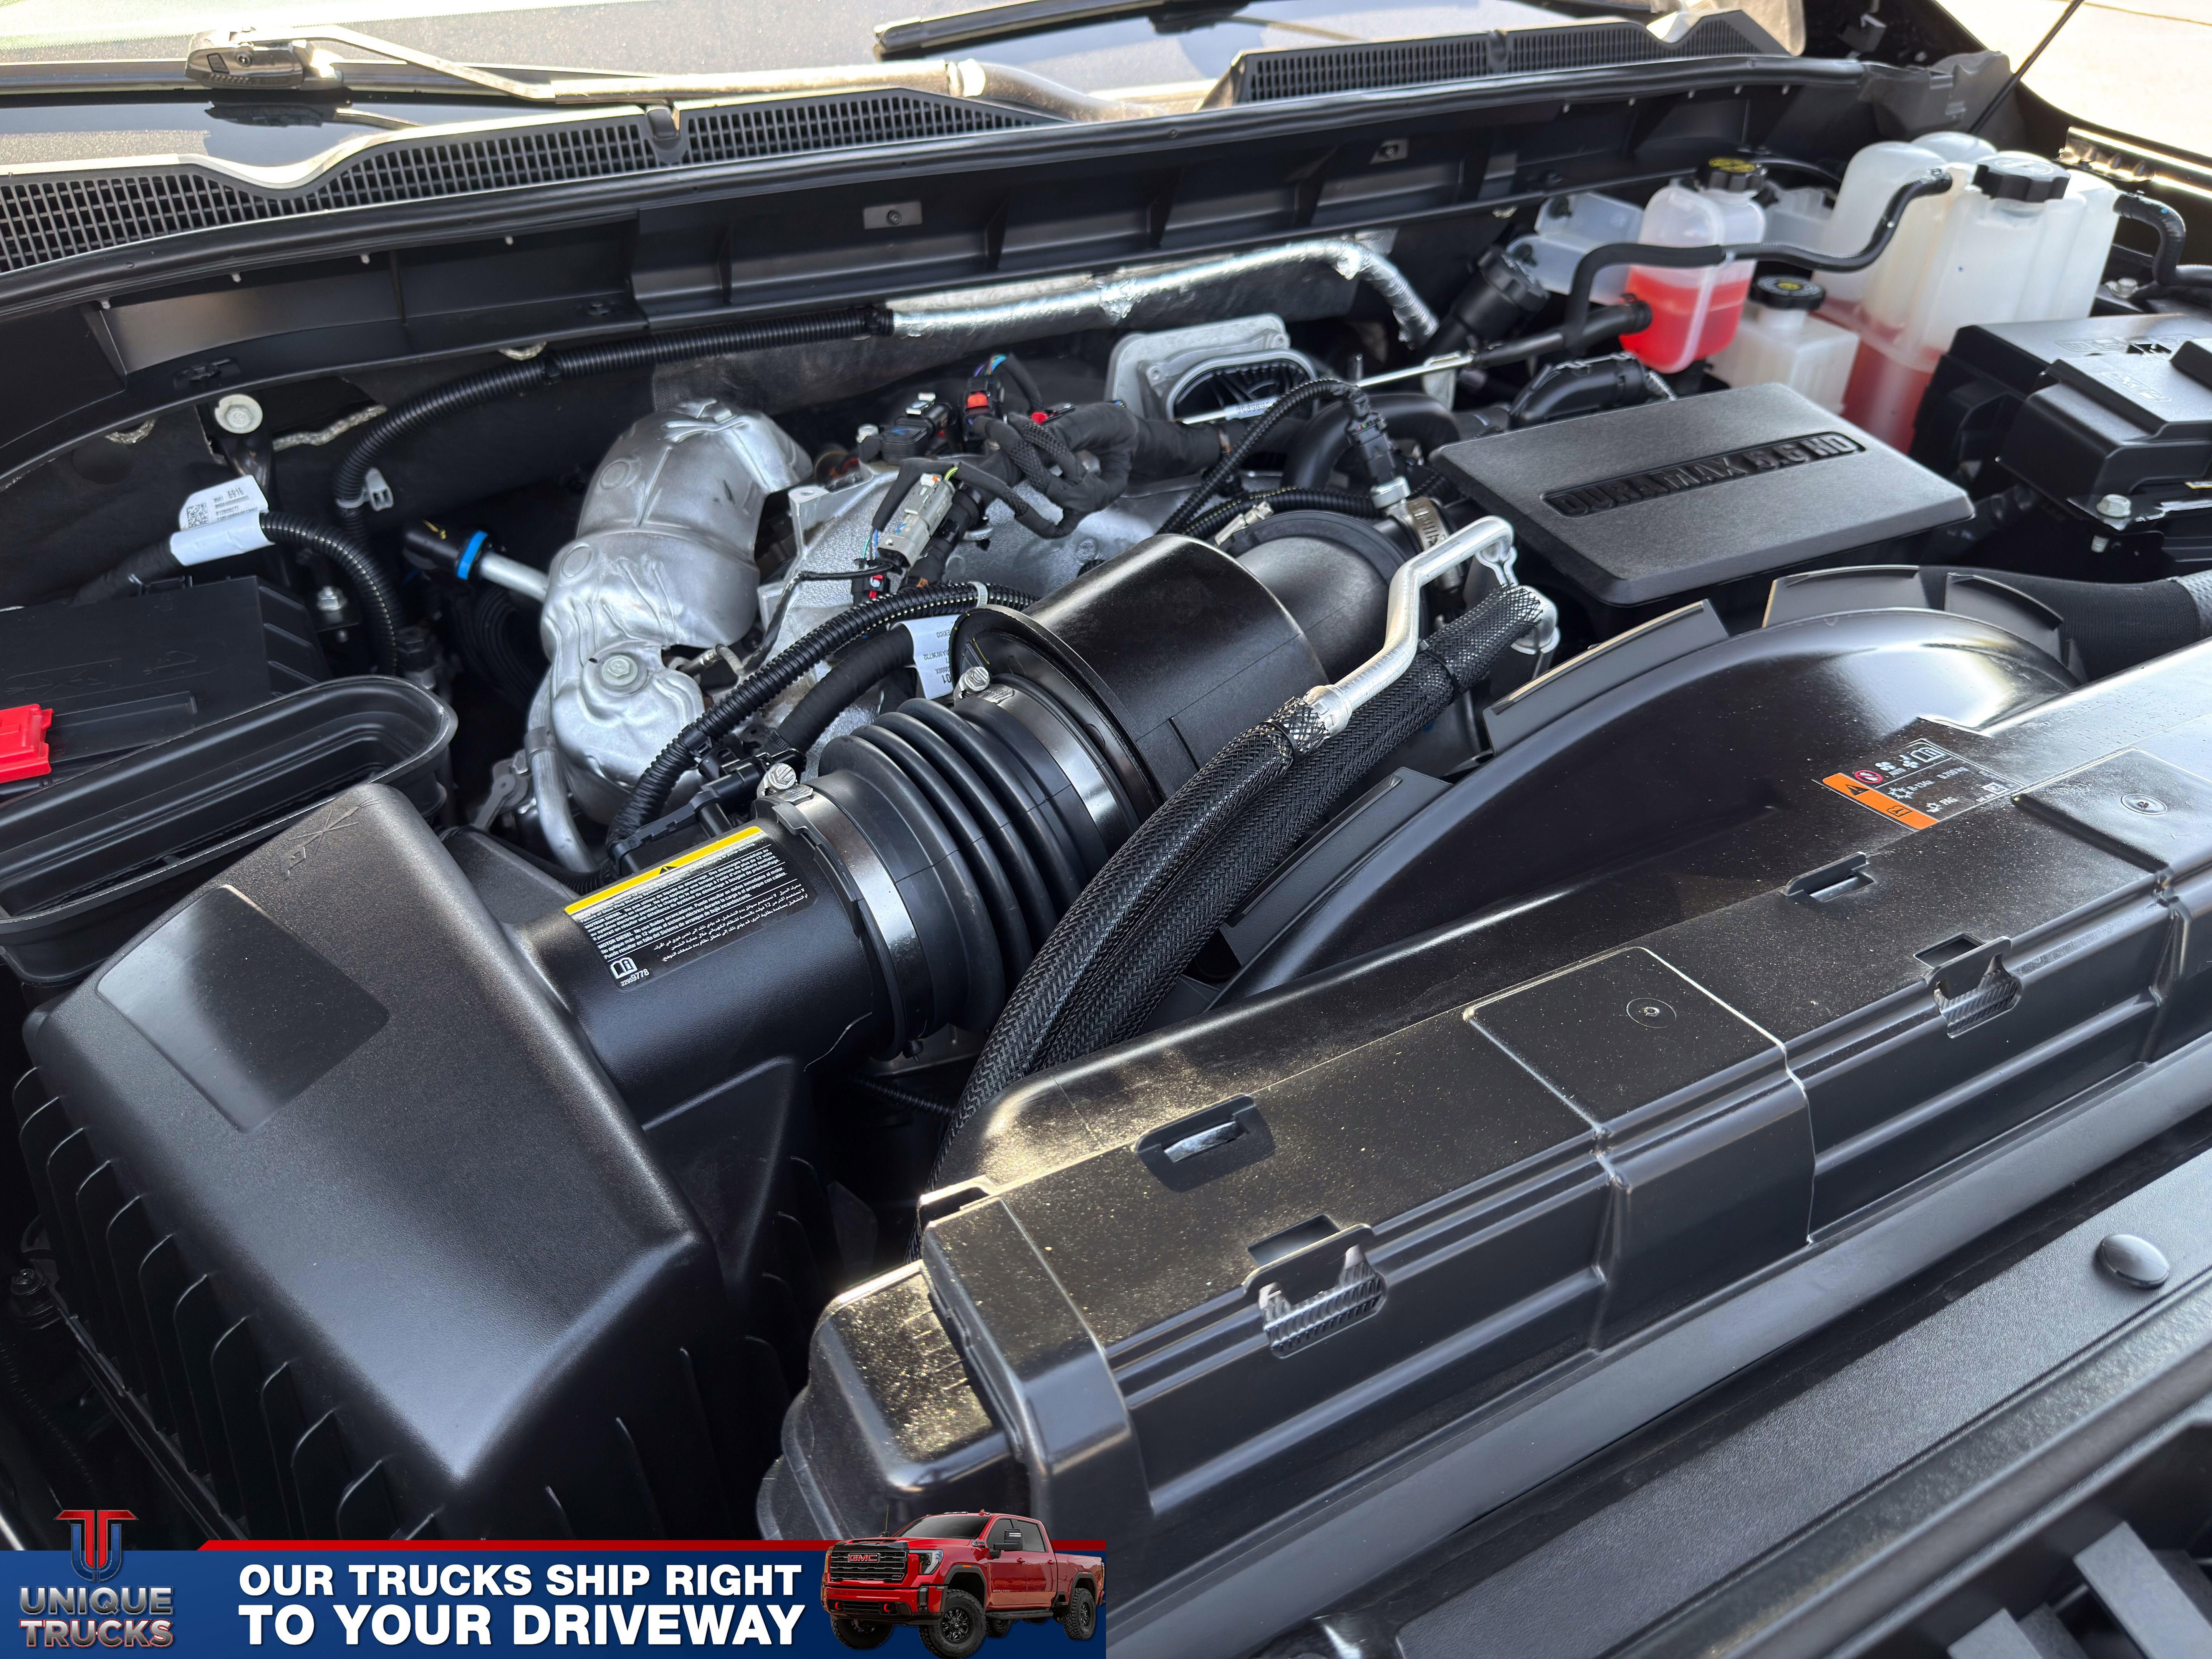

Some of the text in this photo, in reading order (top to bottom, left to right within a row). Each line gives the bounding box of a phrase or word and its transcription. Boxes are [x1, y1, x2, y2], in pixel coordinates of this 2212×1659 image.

[1548, 453, 1748, 515] DURAMAX
[1799, 435, 1858, 456] HD
[1888, 768, 1907, 776] AUTO
[1907, 780, 1934, 791] R-134a
[1939, 796, 1959, 805] PAG
[584, 918, 605, 929] MOTEUR
[604, 911, 622, 920] DIESEL
[641, 897, 656, 905] utiliser
[717, 861, 741, 872] dommages
[588, 924, 604, 932] moteur
[604, 913, 628, 926] pourraient
[669, 887, 689, 897] appliquer
[698, 876, 715, 885] tension
[714, 868, 734, 878] nominale
[596, 929, 614, 940] pourrait
[728, 873, 746, 882] bougies
[598, 939, 616, 949] MOTOR
[615, 932, 633, 941] DIESEL
[649, 918, 665, 927] fluidos
[665, 906, 695, 920] arrancadores.
[708, 892, 724, 901] resultar
[743, 874, 766, 886] inmediatos
[608, 942, 624, 951] aplique
[648, 926, 662, 934] voltios
[667, 916, 685, 925] sistema
[704, 900, 720, 909] durante
[745, 881, 764, 891] arranque
[772, 872, 787, 880] cables.
[624, 895, 642, 904] Starting
[639, 906, 658, 916] pendant
[662, 897, 678, 905] charge
[741, 863, 757, 871] batterie
[604, 951, 619, 959] Puede
[618, 943, 636, 953] resultar
[659, 925, 679, 935] Sistema
[685, 914, 704, 924] arranque
[720, 893, 752, 909] incandescente.
[621, 969, 649, 986] 22959778
